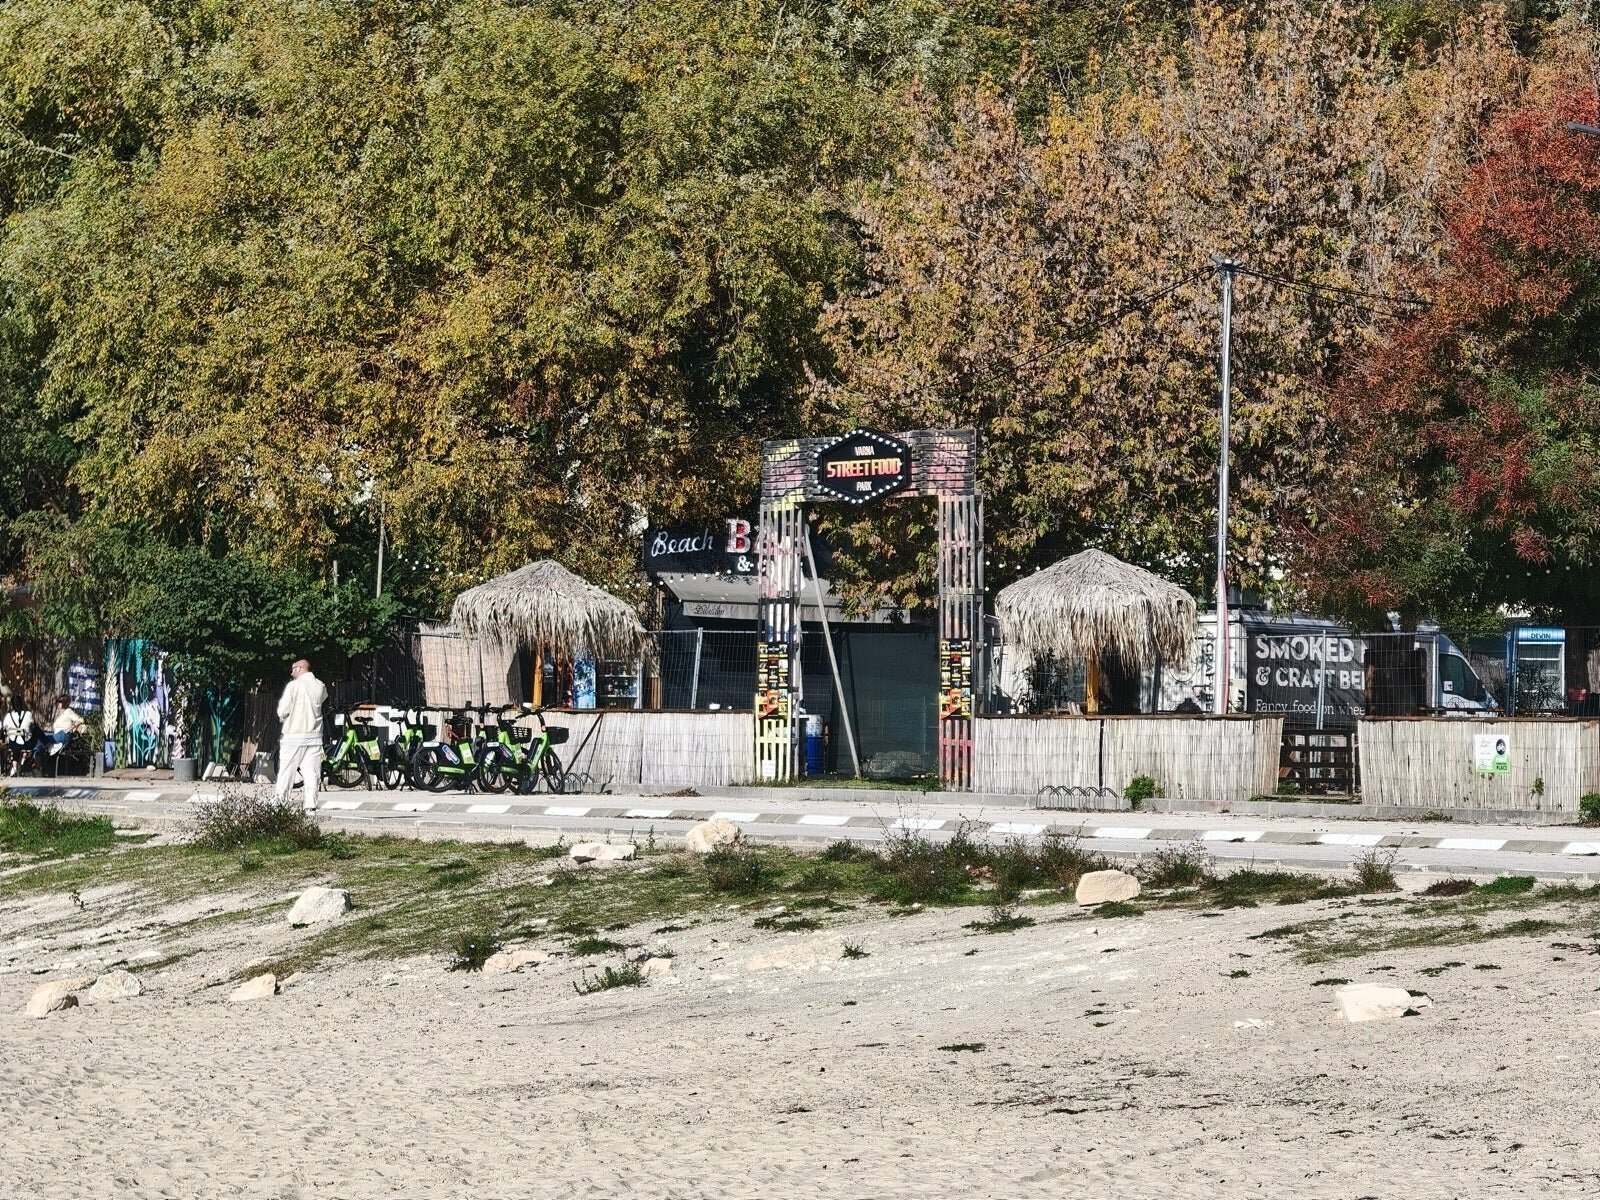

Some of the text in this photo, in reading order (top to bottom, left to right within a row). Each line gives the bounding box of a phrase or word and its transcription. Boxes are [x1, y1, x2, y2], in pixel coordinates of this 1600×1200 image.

[854, 445, 875, 456] VARNA
[827, 457, 902, 478] STREET FOOD
[856, 481, 873, 492] PARK
[651, 528, 714, 557] Beach
[737, 555, 751, 572] &
[1531, 632, 1552, 640] DEVIN
[1255, 634, 1355, 663] SMOKED
[1255, 666, 1271, 687] &
[1275, 667, 1336, 689] CRAFT
[1255, 699, 1289, 713] Fancy
[1292, 700, 1318, 714] food
